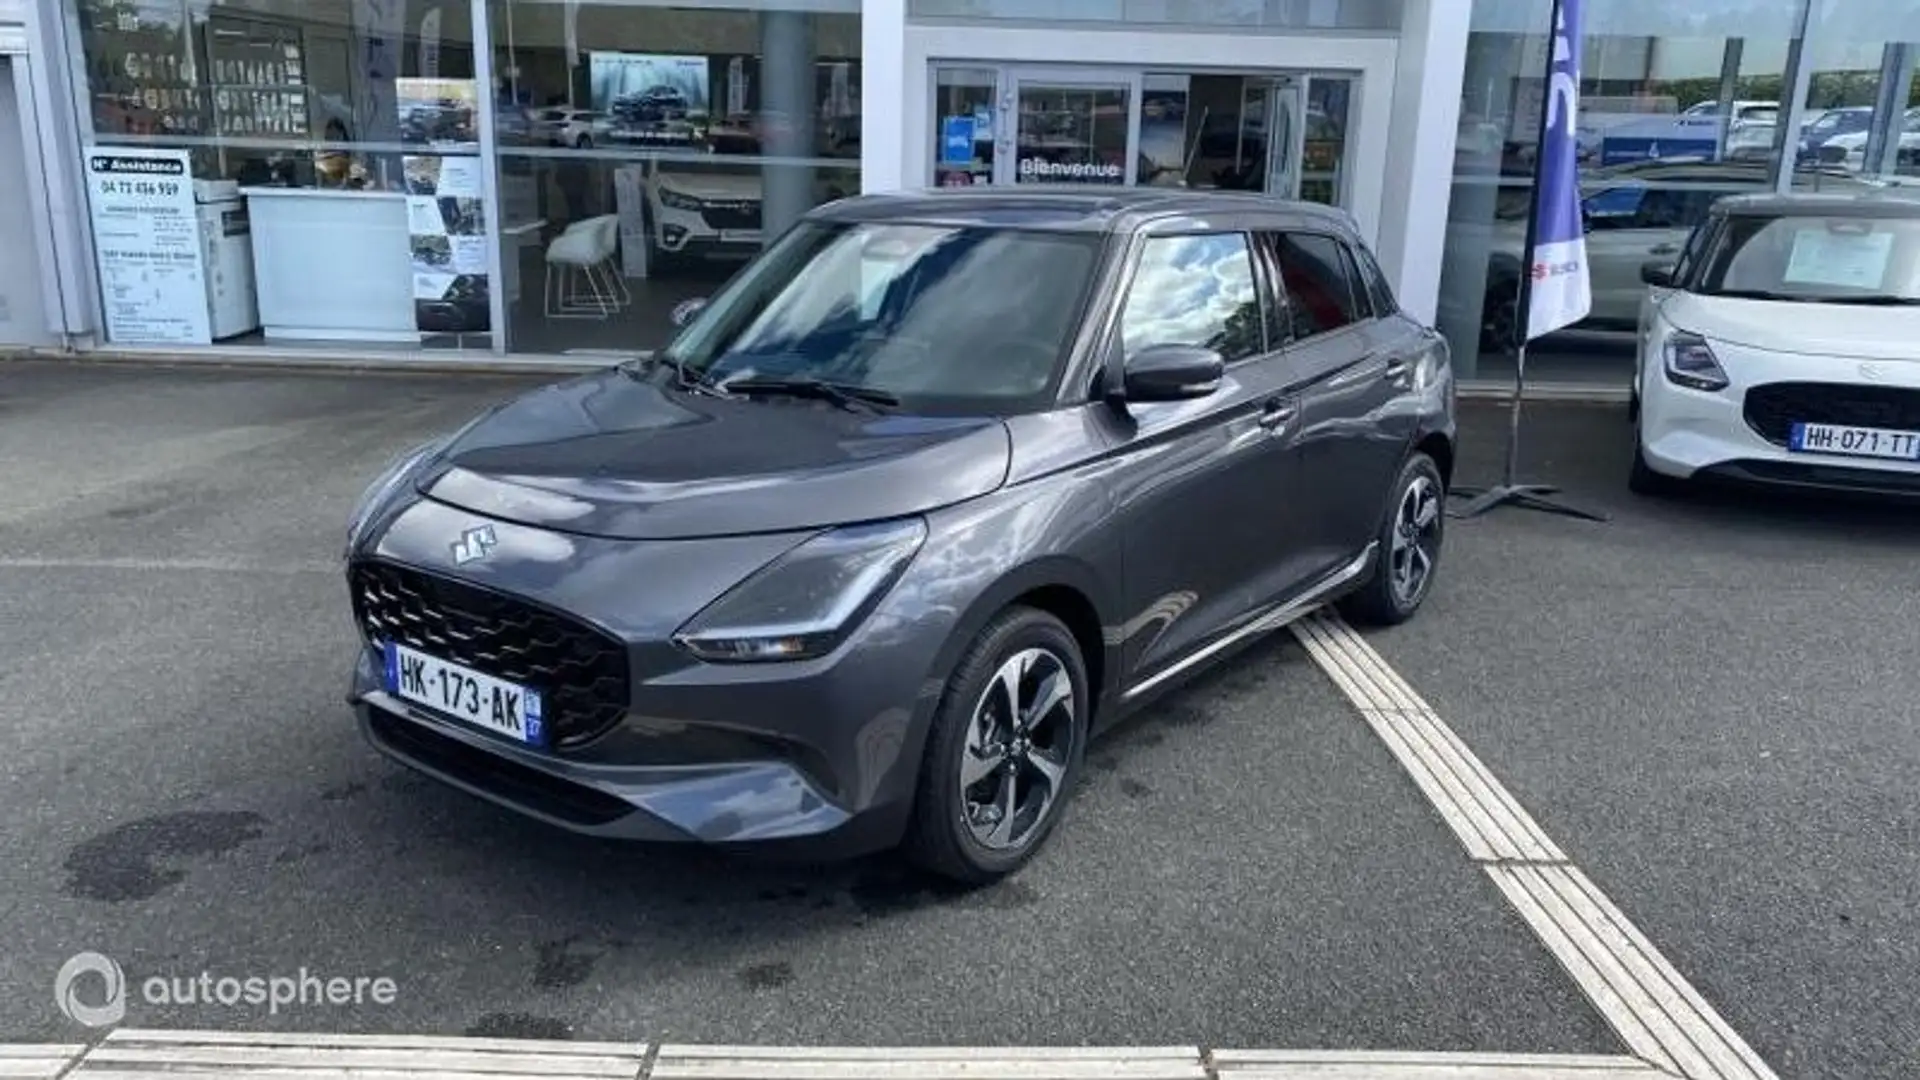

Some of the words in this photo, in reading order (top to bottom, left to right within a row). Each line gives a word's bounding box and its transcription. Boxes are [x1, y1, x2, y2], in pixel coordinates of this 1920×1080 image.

[111, 160, 181, 172] Assistance
[1020, 157, 1120, 176] Bienvenue
[1806, 425, 1916, 455] HH-071-TT
[400, 652, 521, 732] HK-173-AK
